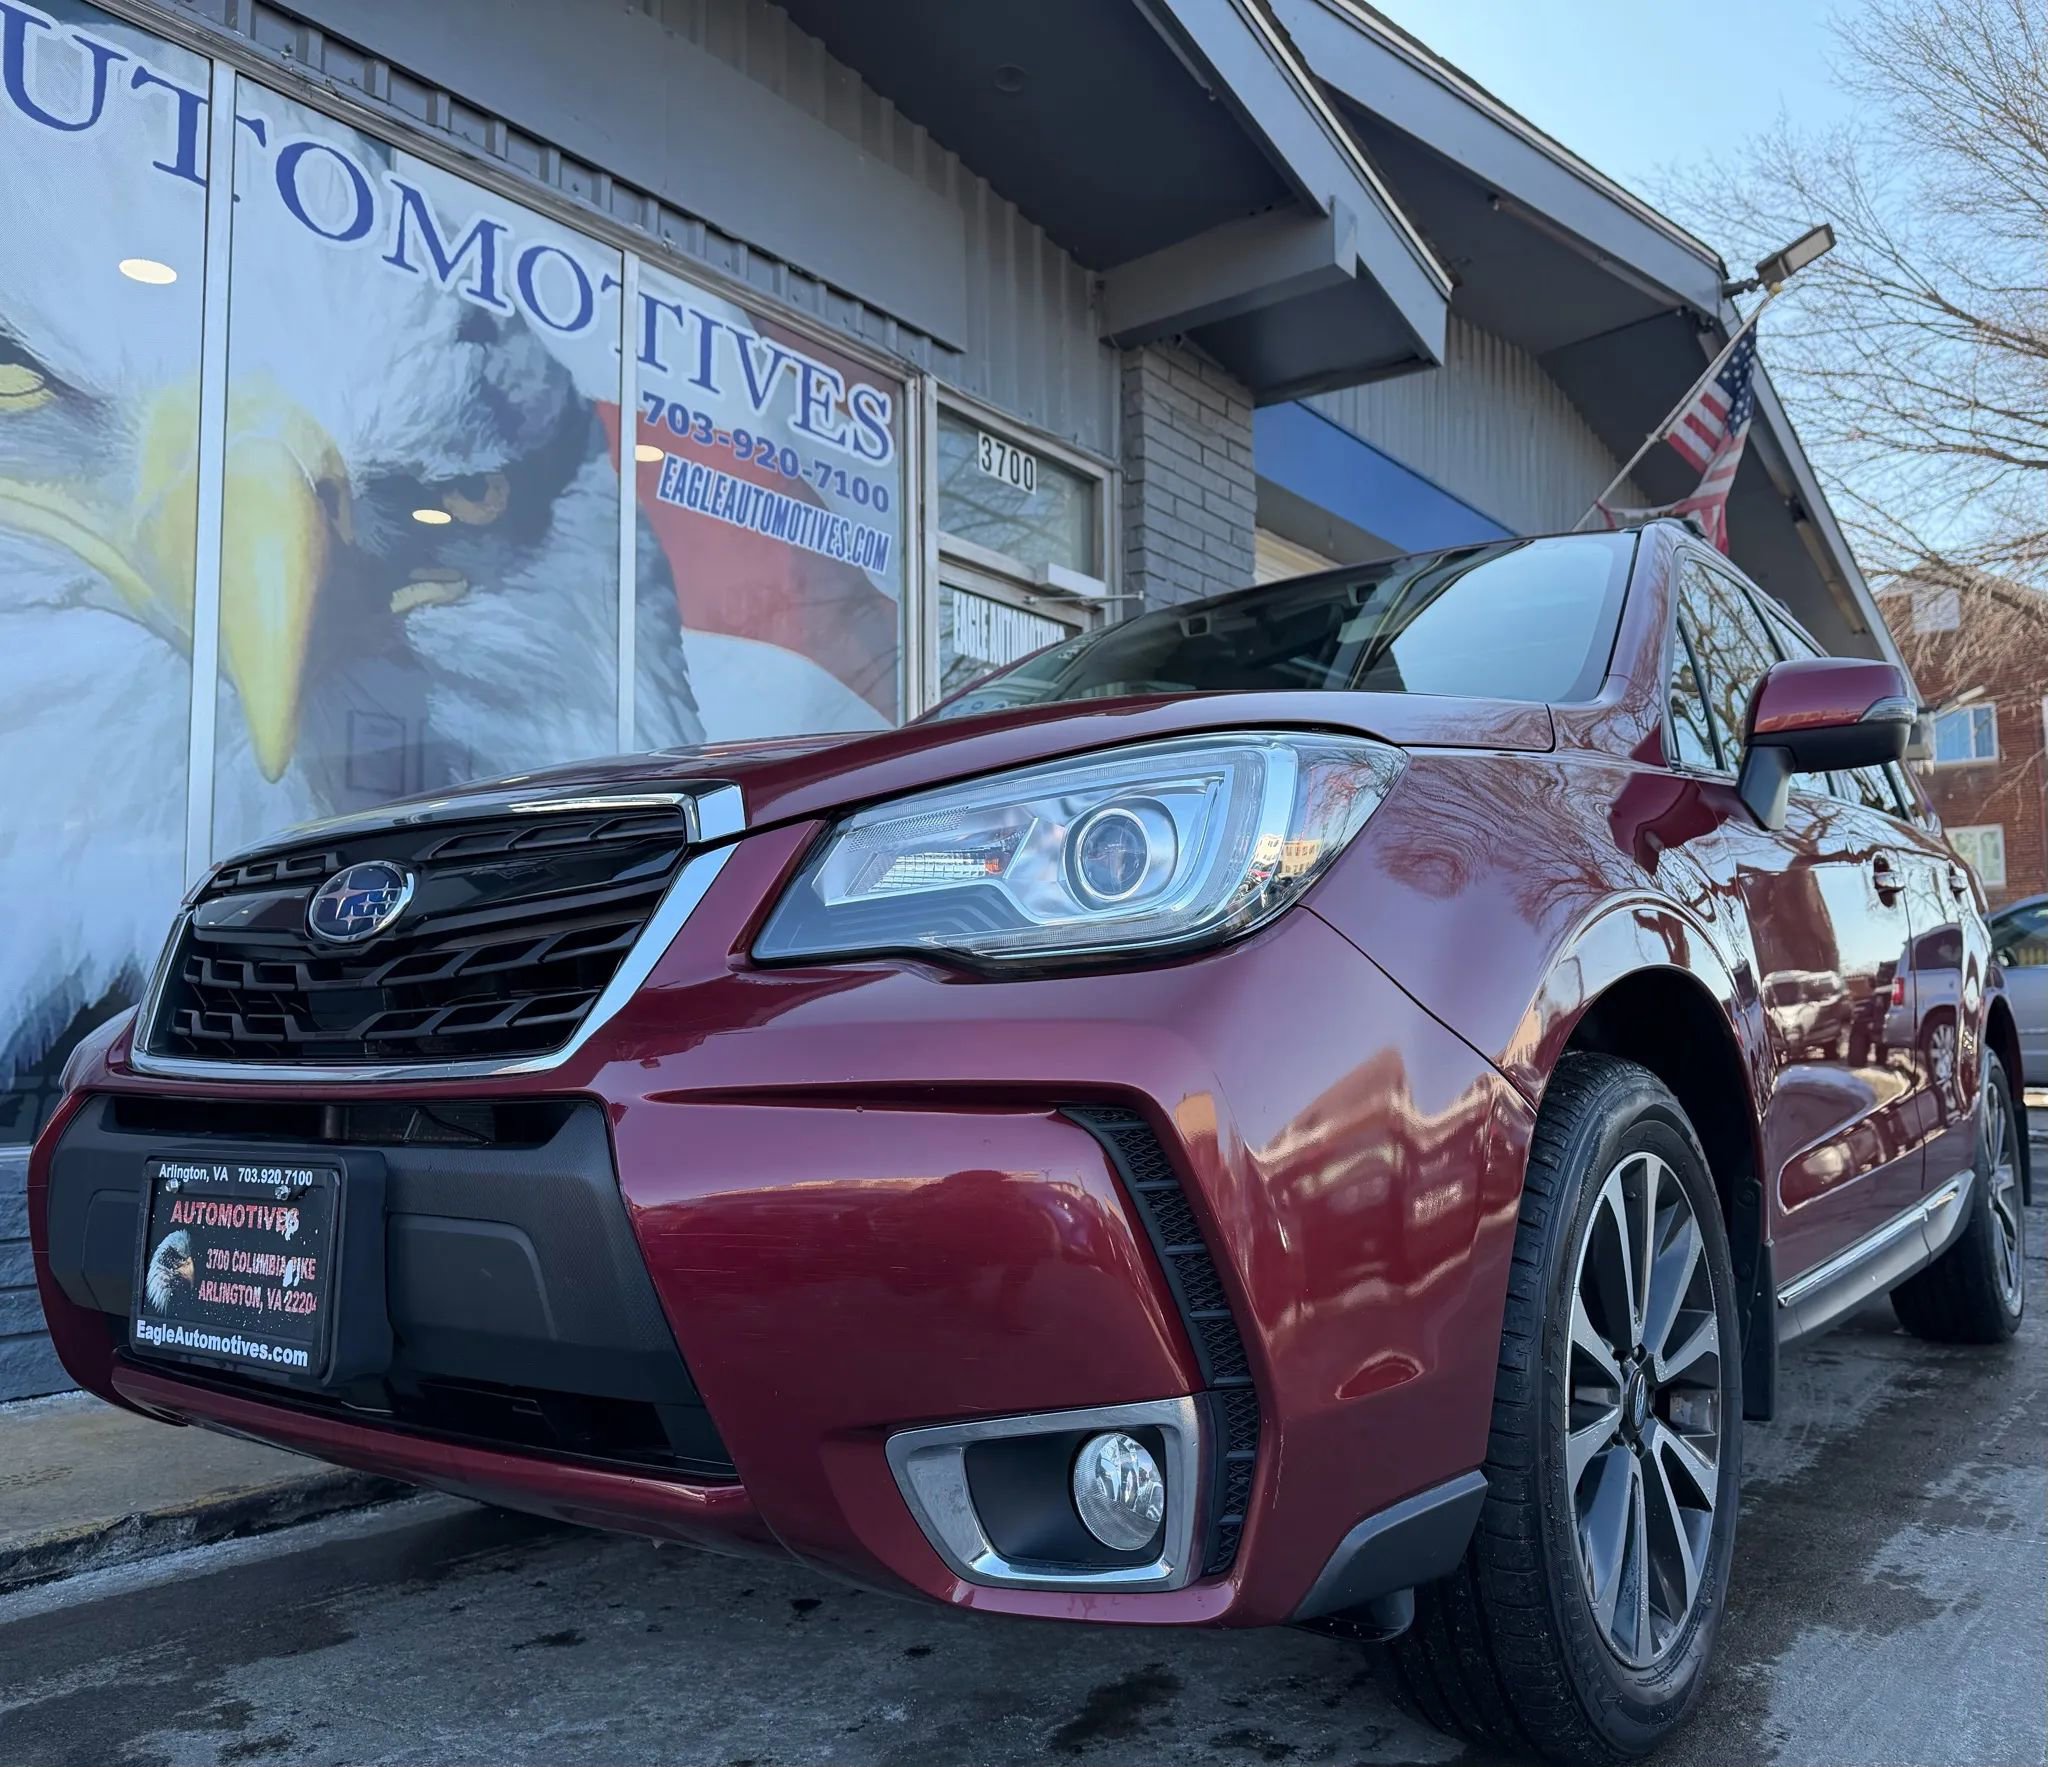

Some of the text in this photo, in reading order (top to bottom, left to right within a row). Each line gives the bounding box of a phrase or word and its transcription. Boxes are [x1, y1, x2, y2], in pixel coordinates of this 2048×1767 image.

[642, 390, 889, 514] 703-920-7100
[981, 436, 1034, 492] 3700
[659, 455, 890, 572] EAGLEAUTOMOTIVES.COM
[953, 589, 1066, 668] EAGLE AUTOMOTI
[159, 1163, 313, 1186] Arlington, VA 703.920.7100
[205, 1248, 230, 1270] 3700
[231, 1249, 287, 1277] COLUMBIA
[197, 1280, 264, 1314] ARLINGTON,
[267, 1287, 283, 1312] VA
[136, 1319, 309, 1368] EagleAutomotives.com
